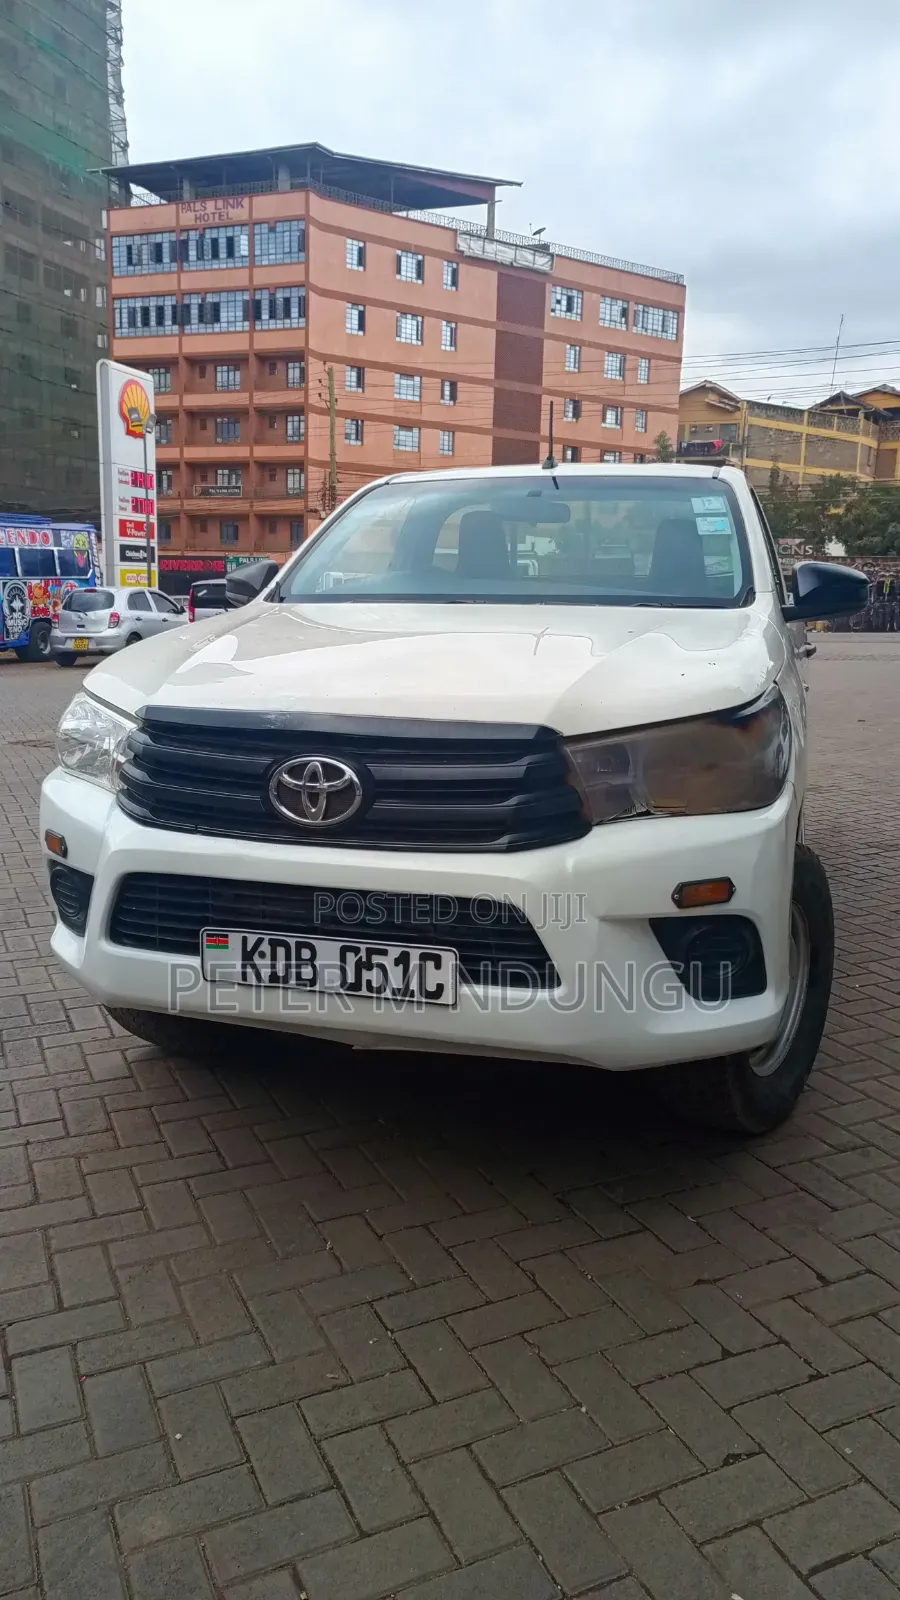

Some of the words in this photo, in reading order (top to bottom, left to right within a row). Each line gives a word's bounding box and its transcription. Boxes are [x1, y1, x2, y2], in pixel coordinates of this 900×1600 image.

[181, 200, 207, 213] PALS
[214, 197, 245, 211] LINK
[194, 211, 233, 223] HOTEL
[241, 935, 317, 988] KDB
[340, 944, 445, 1000] 051C
